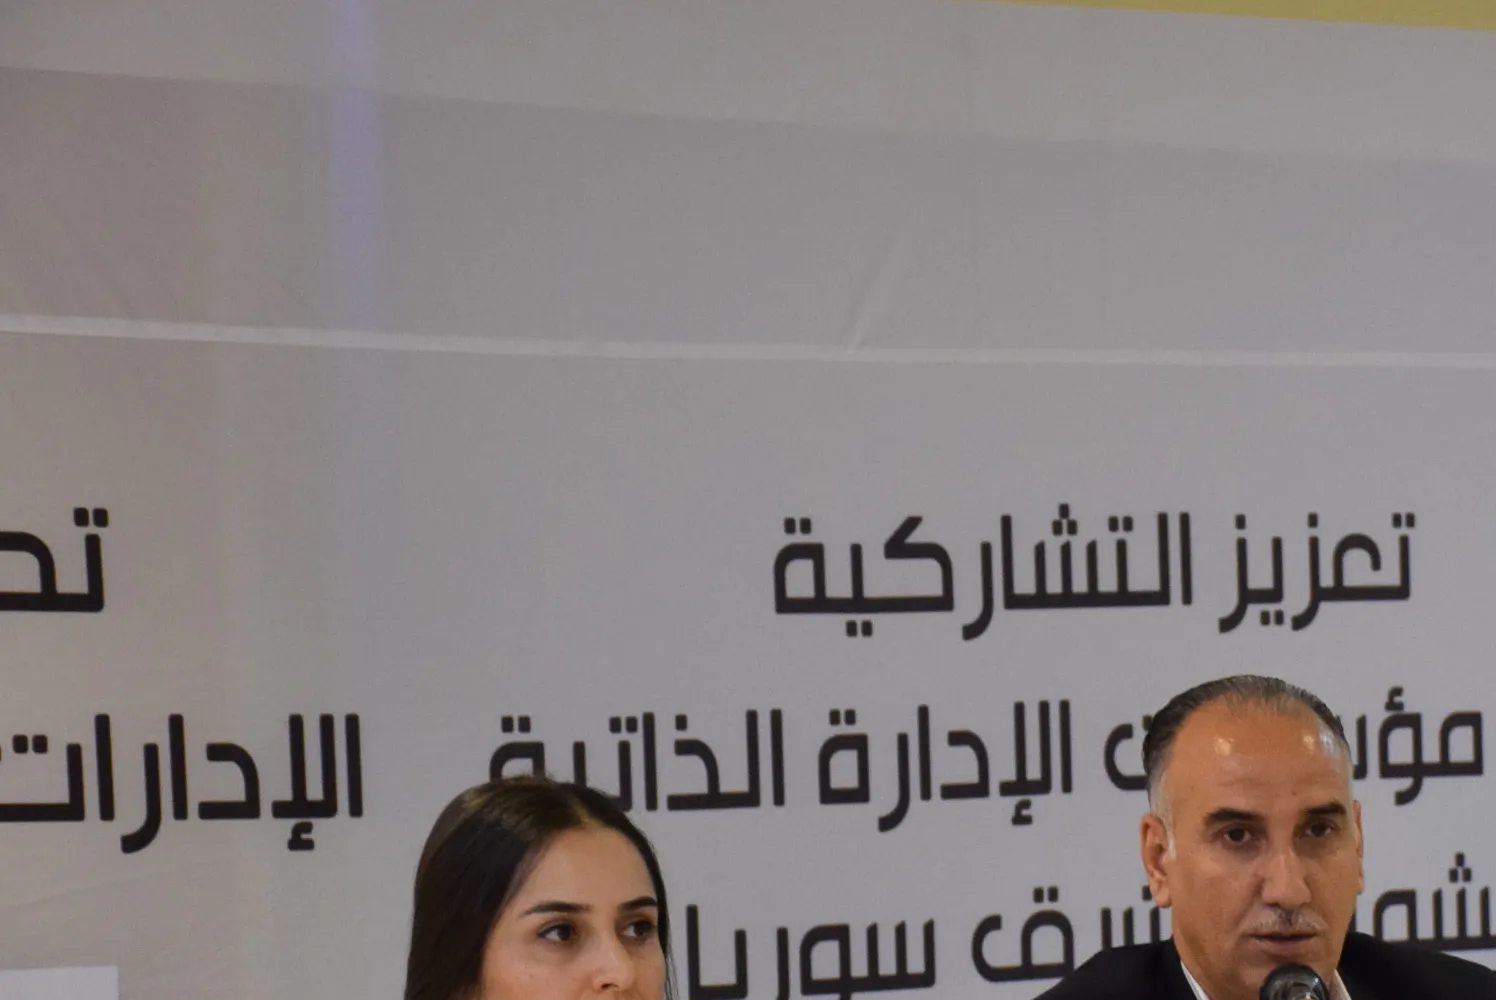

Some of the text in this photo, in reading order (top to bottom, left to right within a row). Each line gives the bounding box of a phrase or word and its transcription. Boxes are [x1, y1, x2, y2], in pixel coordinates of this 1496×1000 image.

[773, 504, 1415, 641] تعزيز التشاركية
[0, 714, 363, 854] الإدارات
[818, 700, 1072, 832] الإدارة
